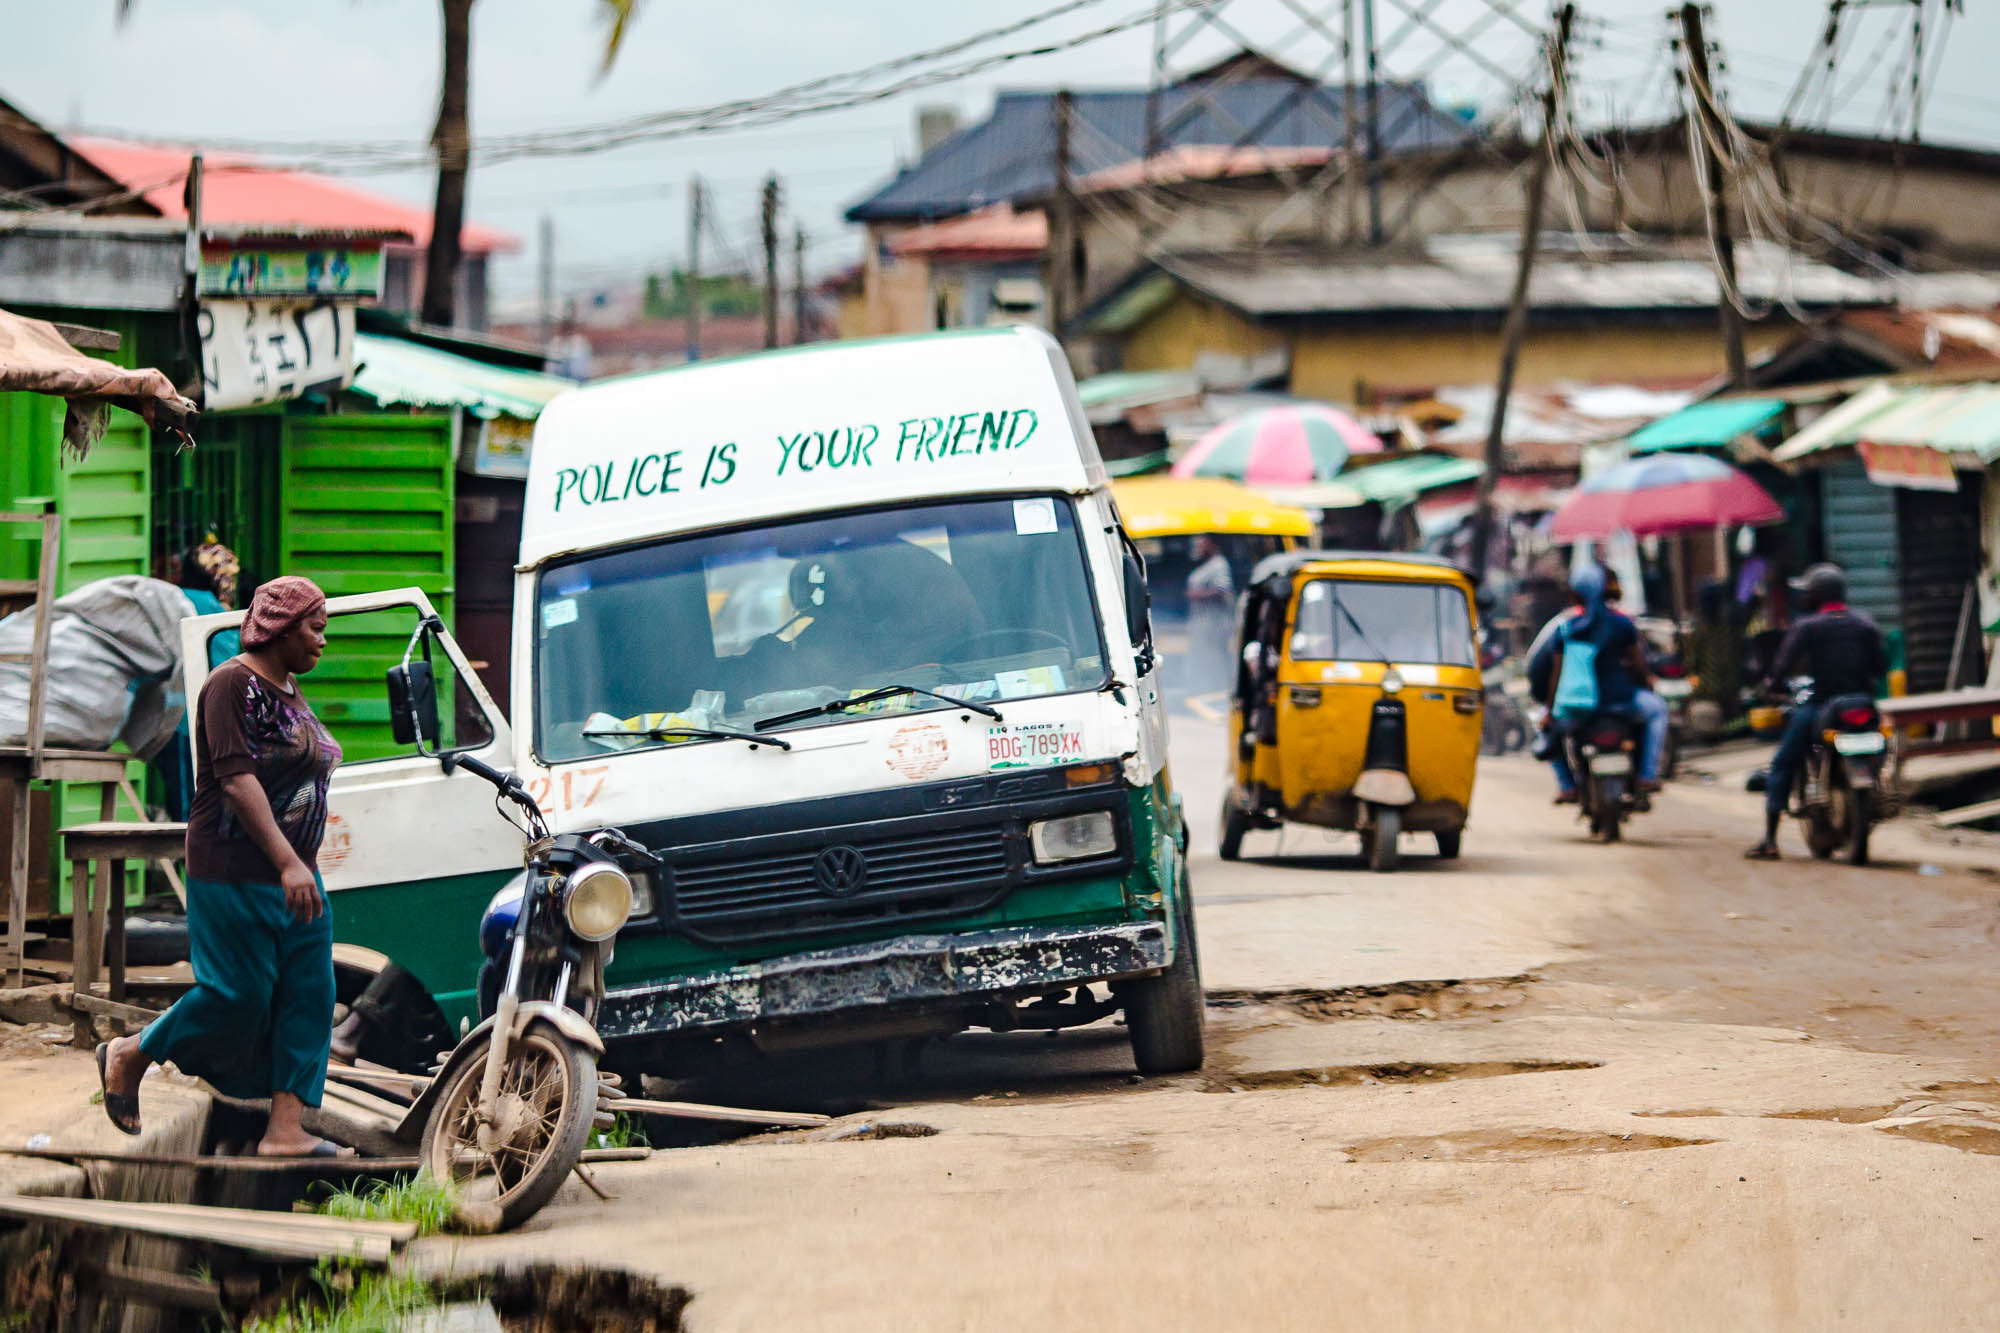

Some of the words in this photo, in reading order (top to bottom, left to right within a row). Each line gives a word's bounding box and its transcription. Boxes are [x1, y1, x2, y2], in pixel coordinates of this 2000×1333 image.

[555, 450, 683, 512] POLICE
[700, 442, 738, 488] IS
[776, 424, 880, 476] YOUR
[896, 408, 1040, 462] FRIEND
[529, 765, 609, 814] 217
